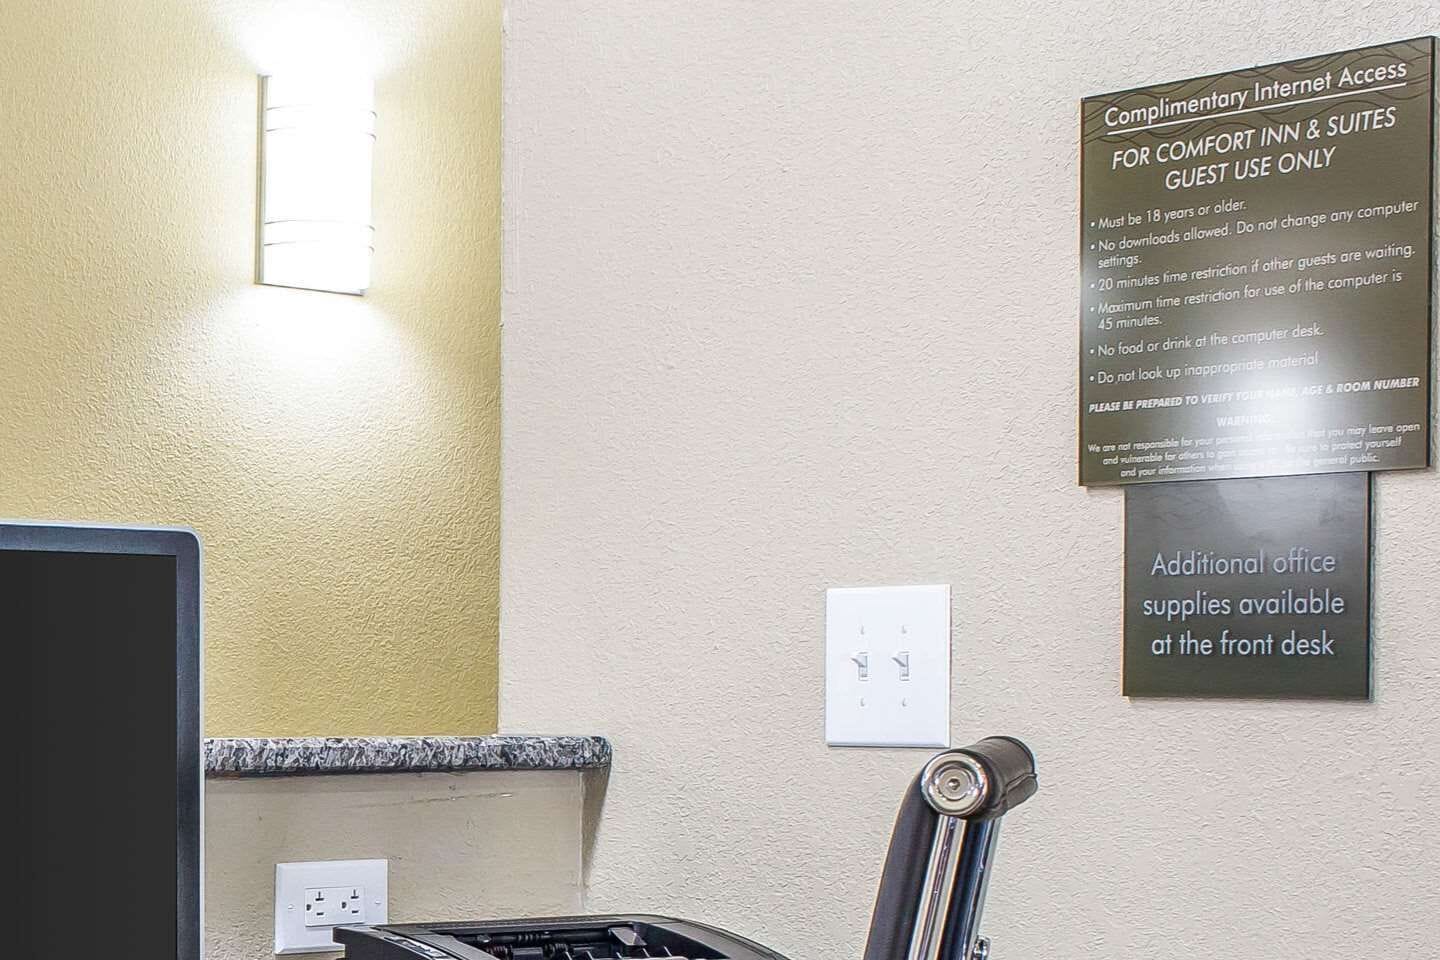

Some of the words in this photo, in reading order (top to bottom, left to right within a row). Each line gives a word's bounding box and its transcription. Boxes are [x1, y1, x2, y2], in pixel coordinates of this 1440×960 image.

[1105, 90, 1248, 126] Complimentary
[1255, 72, 1332, 102] Internet
[1338, 63, 1407, 88] Access
[1112, 147, 1150, 170] FOR
[1156, 129, 1256, 163] COMFORT
[1261, 122, 1300, 146] INN
[1306, 119, 1320, 139] &
[1327, 106, 1396, 137] SUITES
[1165, 163, 1229, 190] GUEST
[1235, 156, 1271, 180] USE
[1278, 146, 1336, 173] ONLY
[1098, 216, 1124, 229] Must
[1128, 213, 1142, 225] be
[1147, 209, 1160, 222] 18
[1164, 207, 1194, 223] years
[1198, 204, 1210, 215] or
[1214, 199, 1247, 213] older.
[1098, 240, 1114, 252] No
[1118, 230, 1180, 250] downloads
[1183, 224, 1232, 241] allowed.
[1237, 221, 1254, 234] Do
[1258, 218, 1277, 231] not
[1281, 214, 1327, 228] change
[1330, 209, 1354, 223] any
[1357, 201, 1419, 218] computer
[1098, 254, 1142, 269] settings.
[1098, 278, 1113, 291] 20
[1116, 273, 1160, 289] minutes
[1163, 270, 1188, 283] time
[1191, 263, 1247, 280] restriction
[1251, 259, 1260, 272] if
[1263, 256, 1294, 272] other
[1298, 252, 1336, 270] guests
[1340, 253, 1362, 263] are
[1365, 243, 1416, 259] waiting.
[1098, 298, 1153, 315] Maximum
[1156, 295, 1180, 309] time
[1184, 288, 1240, 306] restriction
[1244, 285, 1260, 298] for
[1264, 286, 1286, 296] use
[1289, 279, 1303, 293] of
[1305, 277, 1324, 291] the
[1328, 272, 1388, 290] computer
[1392, 269, 1402, 282] is
[1098, 318, 1113, 330] 45
[1116, 315, 1162, 329] minutes.
[1098, 345, 1114, 357] No
[1118, 341, 1143, 355] food
[1147, 343, 1160, 352] or
[1162, 336, 1192, 351] drink
[1195, 336, 1207, 348] at
[1210, 333, 1228, 345] the
[1231, 328, 1288, 345] computer
[1292, 322, 1324, 338] desk.
[1098, 371, 1114, 384] Do
[1117, 370, 1135, 382] not
[1138, 366, 1162, 381] look
[1166, 368, 1181, 380] up
[1184, 358, 1264, 376] inappropriate
[1089, 401, 1121, 413] PLEASE
[1122, 400, 1133, 410] BE
[1136, 396, 1183, 410] PREPARED
[1185, 395, 1199, 405] TO
[1201, 392, 1232, 404] VERIFY
[1300, 384, 1323, 396] AGE
[1325, 384, 1334, 394] &
[1336, 381, 1371, 393] ROOM
[1374, 377, 1420, 390] NUMBER
[1088, 444, 1100, 453] We
[1102, 443, 1116, 452] are
[1118, 442, 1131, 451] not
[1133, 438, 1180, 452] responsible
[1181, 437, 1193, 447] for
[1194, 437, 1214, 448] your
[1369, 424, 1393, 434] leave
[1396, 423, 1420, 434] open
[1103, 456, 1118, 465] and
[1120, 451, 1162, 464] vulnerable
[1165, 451, 1176, 461] for
[1365, 436, 1402, 450] yourself
[1120, 467, 1136, 477] and
[1138, 467, 1156, 478] your
[1151, 551, 1264, 575] Additional
[1273, 548, 1336, 573] office
[1143, 590, 1231, 621] supplies
[1239, 589, 1345, 615] available
[1152, 634, 1171, 655] at
[1179, 630, 1212, 655] the
[1220, 629, 1273, 655] front
[1281, 629, 1334, 656] desk
